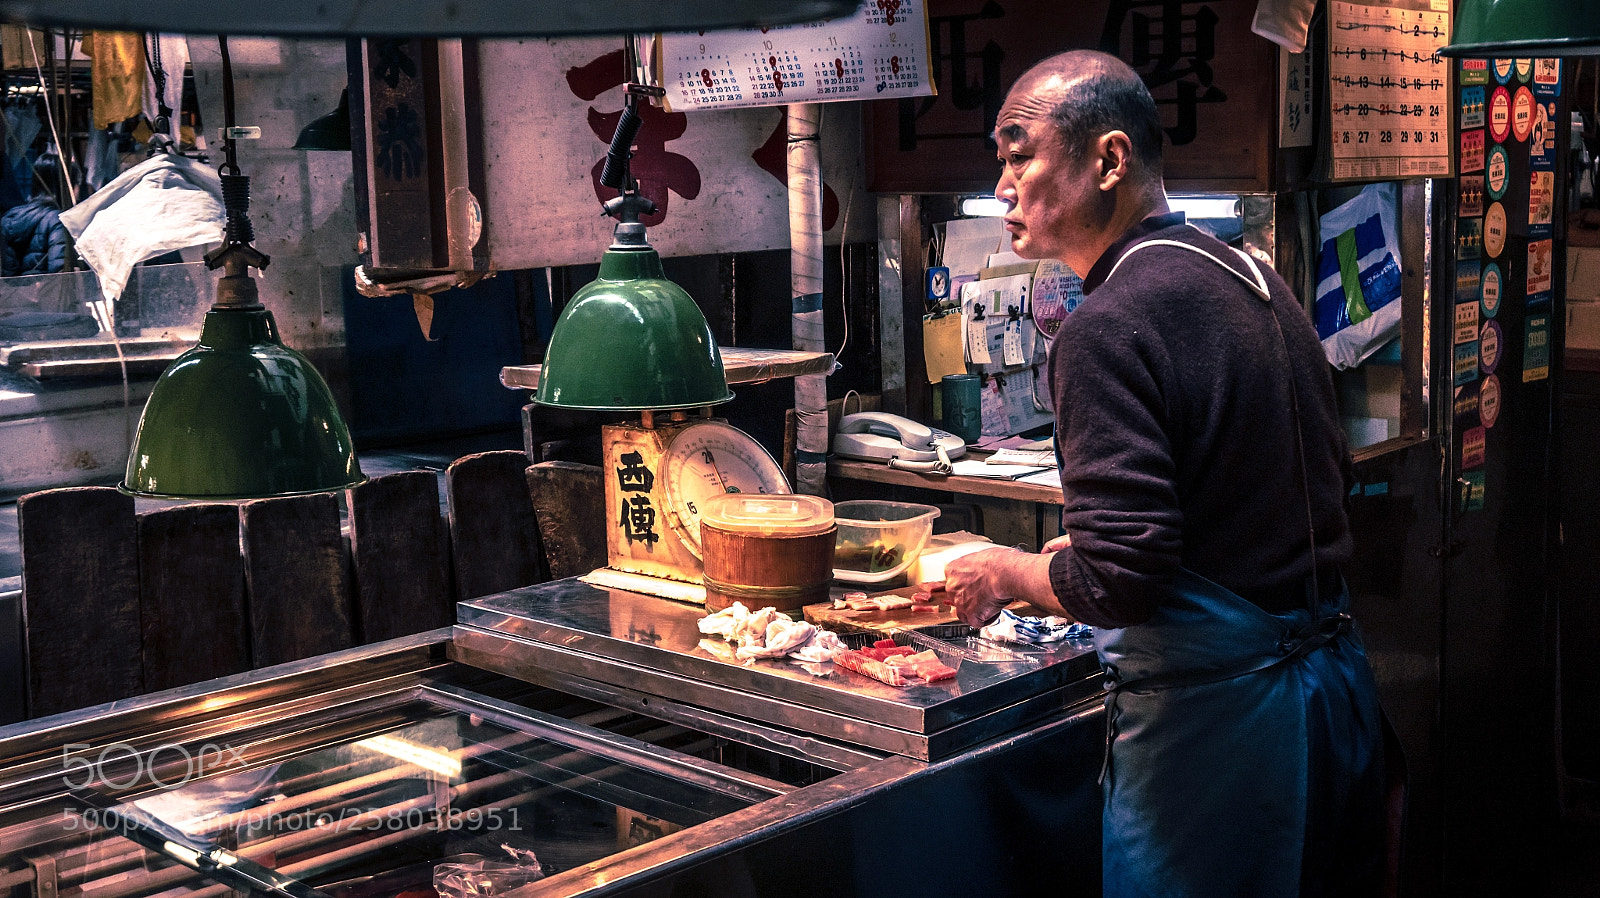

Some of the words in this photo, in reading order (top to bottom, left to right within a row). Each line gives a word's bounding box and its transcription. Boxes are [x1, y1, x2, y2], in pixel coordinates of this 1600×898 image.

[889, 32, 897, 42] 12
[1414, 25, 1419, 37] 2
[1433, 26, 1438, 38] 3
[763, 40, 773, 50] 10
[828, 36, 837, 46] 11
[700, 44, 705, 54] 9
[1346, 47, 1349, 59] 5
[1360, 48, 1366, 60] 6
[1382, 49, 1388, 60] 7
[1400, 50, 1405, 62] 8
[1414, 52, 1418, 63] 9
[1431, 53, 1440, 64] 10
[1345, 75, 1350, 87] 12
[1359, 76, 1369, 88] 13
[1380, 77, 1390, 88] 14
[1400, 78, 1407, 89] 15
[1413, 78, 1421, 90] 16
[1430, 79, 1439, 90] 17
[1344, 104, 1349, 115] 19
[1358, 104, 1369, 116] 20
[1380, 104, 1390, 115] 21
[1400, 105, 1407, 116] 22
[1414, 105, 1421, 116] 23
[1430, 105, 1439, 117] 24
[1343, 131, 1349, 143] 26
[1358, 131, 1369, 143] 27
[1380, 131, 1392, 143] 28
[1401, 131, 1408, 143] 29
[1414, 131, 1422, 143] 30
[1430, 131, 1438, 143] 31
[687, 502, 697, 515] 15
